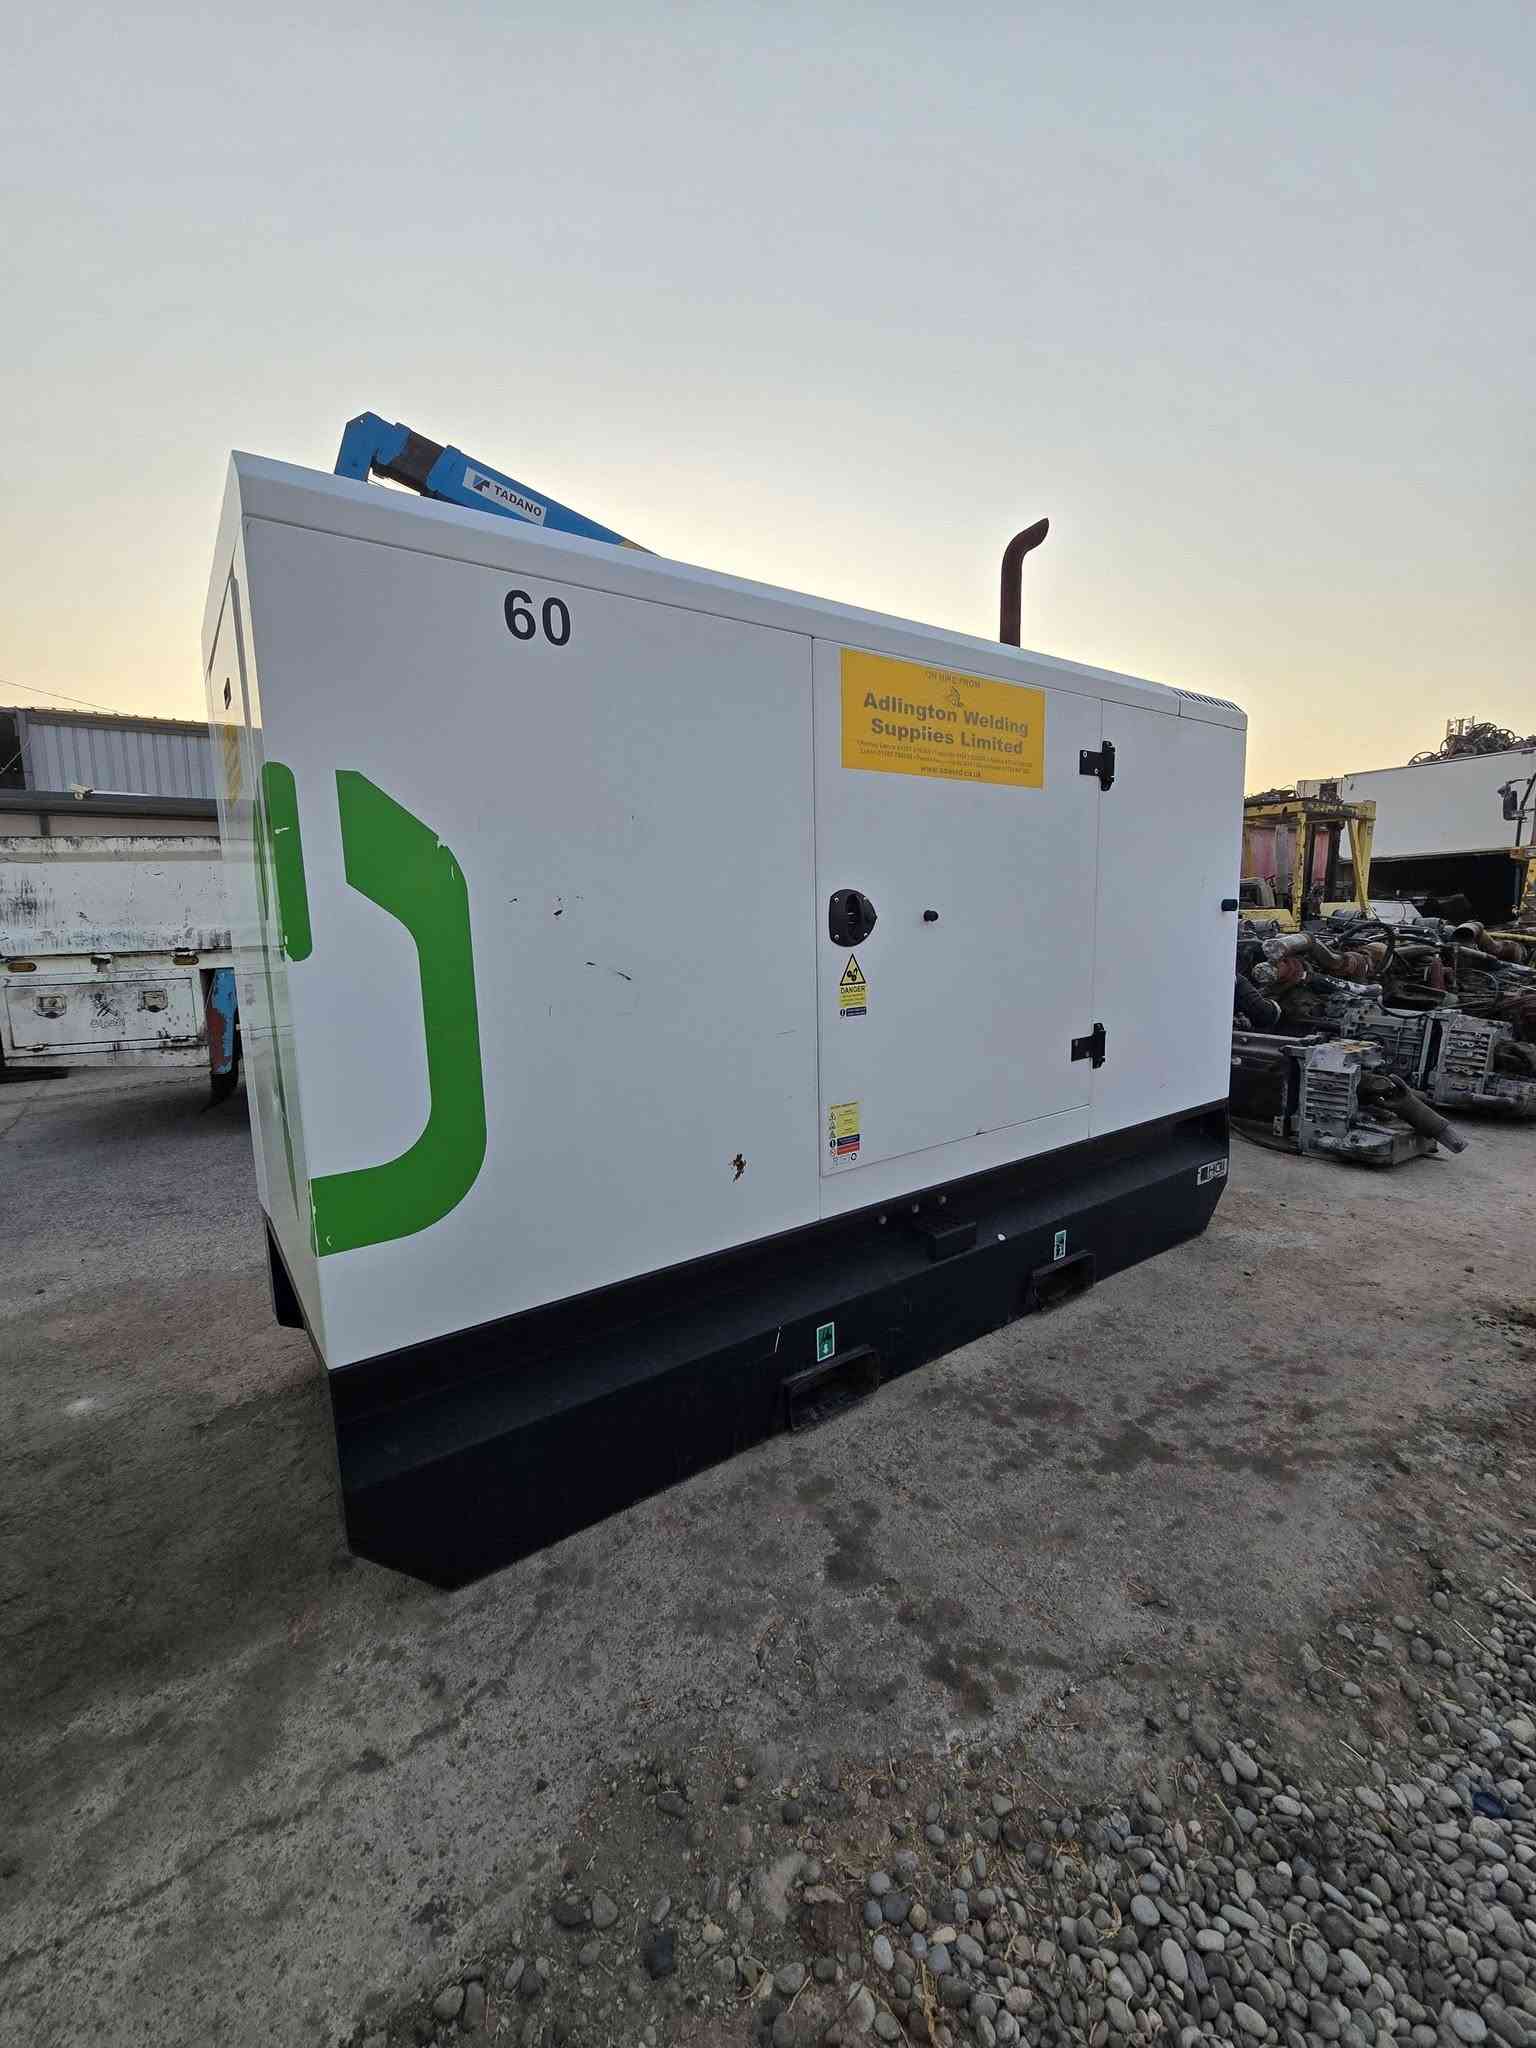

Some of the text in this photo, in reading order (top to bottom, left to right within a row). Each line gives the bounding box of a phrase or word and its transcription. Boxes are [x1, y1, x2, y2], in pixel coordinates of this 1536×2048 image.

[494, 484, 542, 517] TADANO
[504, 589, 571, 647] 60
[863, 692, 1029, 736] Adlington Welding
[871, 718, 954, 744] Supplies
[961, 732, 1023, 754] Limited
[840, 986, 865, 994] DANGER
